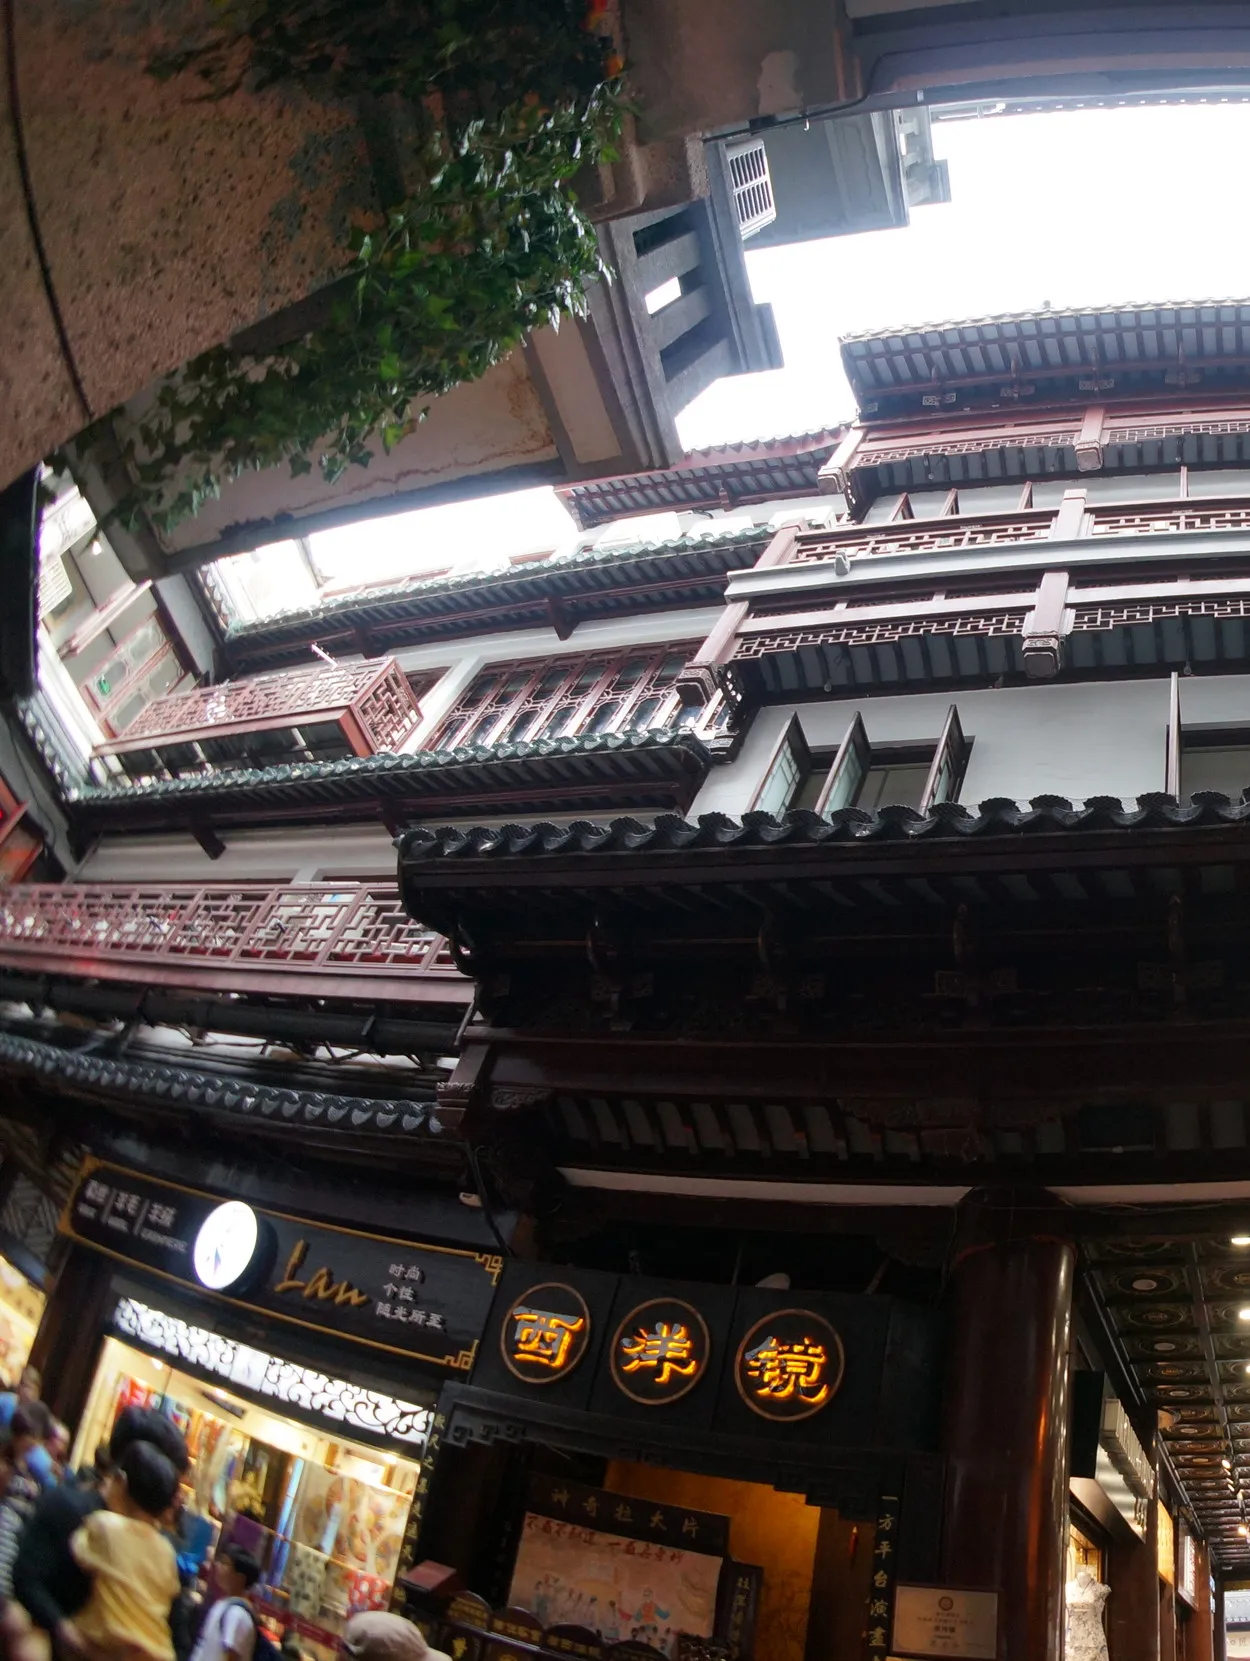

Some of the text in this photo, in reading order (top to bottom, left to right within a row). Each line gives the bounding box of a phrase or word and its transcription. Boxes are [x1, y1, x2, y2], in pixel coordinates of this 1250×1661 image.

[388, 1262, 422, 1282] 时尚
[382, 1282, 416, 1303] 个性
[375, 1302, 444, 1330] 随光所至
